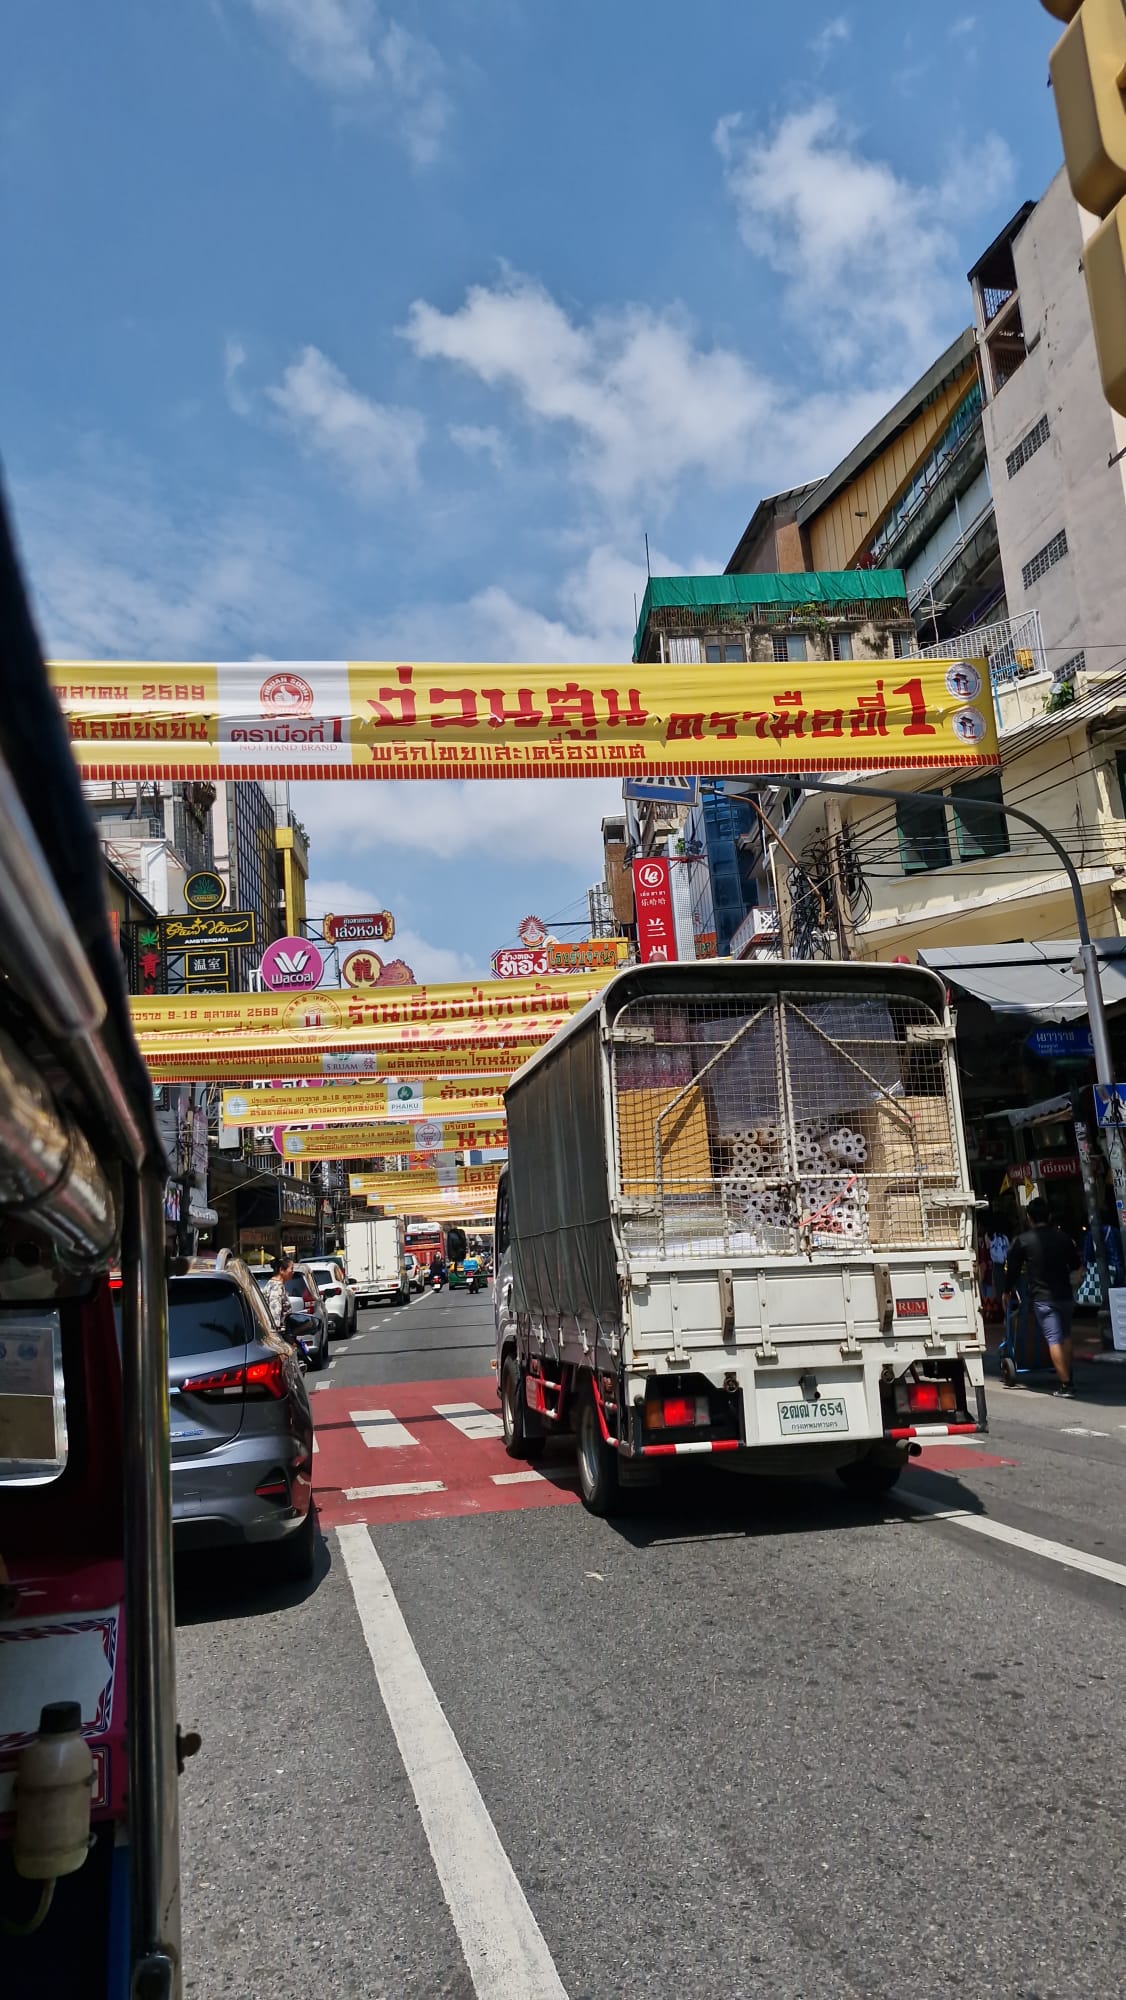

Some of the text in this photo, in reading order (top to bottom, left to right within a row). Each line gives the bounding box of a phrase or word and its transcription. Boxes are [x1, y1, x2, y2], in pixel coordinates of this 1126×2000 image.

[142, 684, 205, 700] 2569
[266, 744, 298, 752] HAND
[301, 744, 338, 752] BRAND
[391, 1103, 419, 1112] PHAIKU
